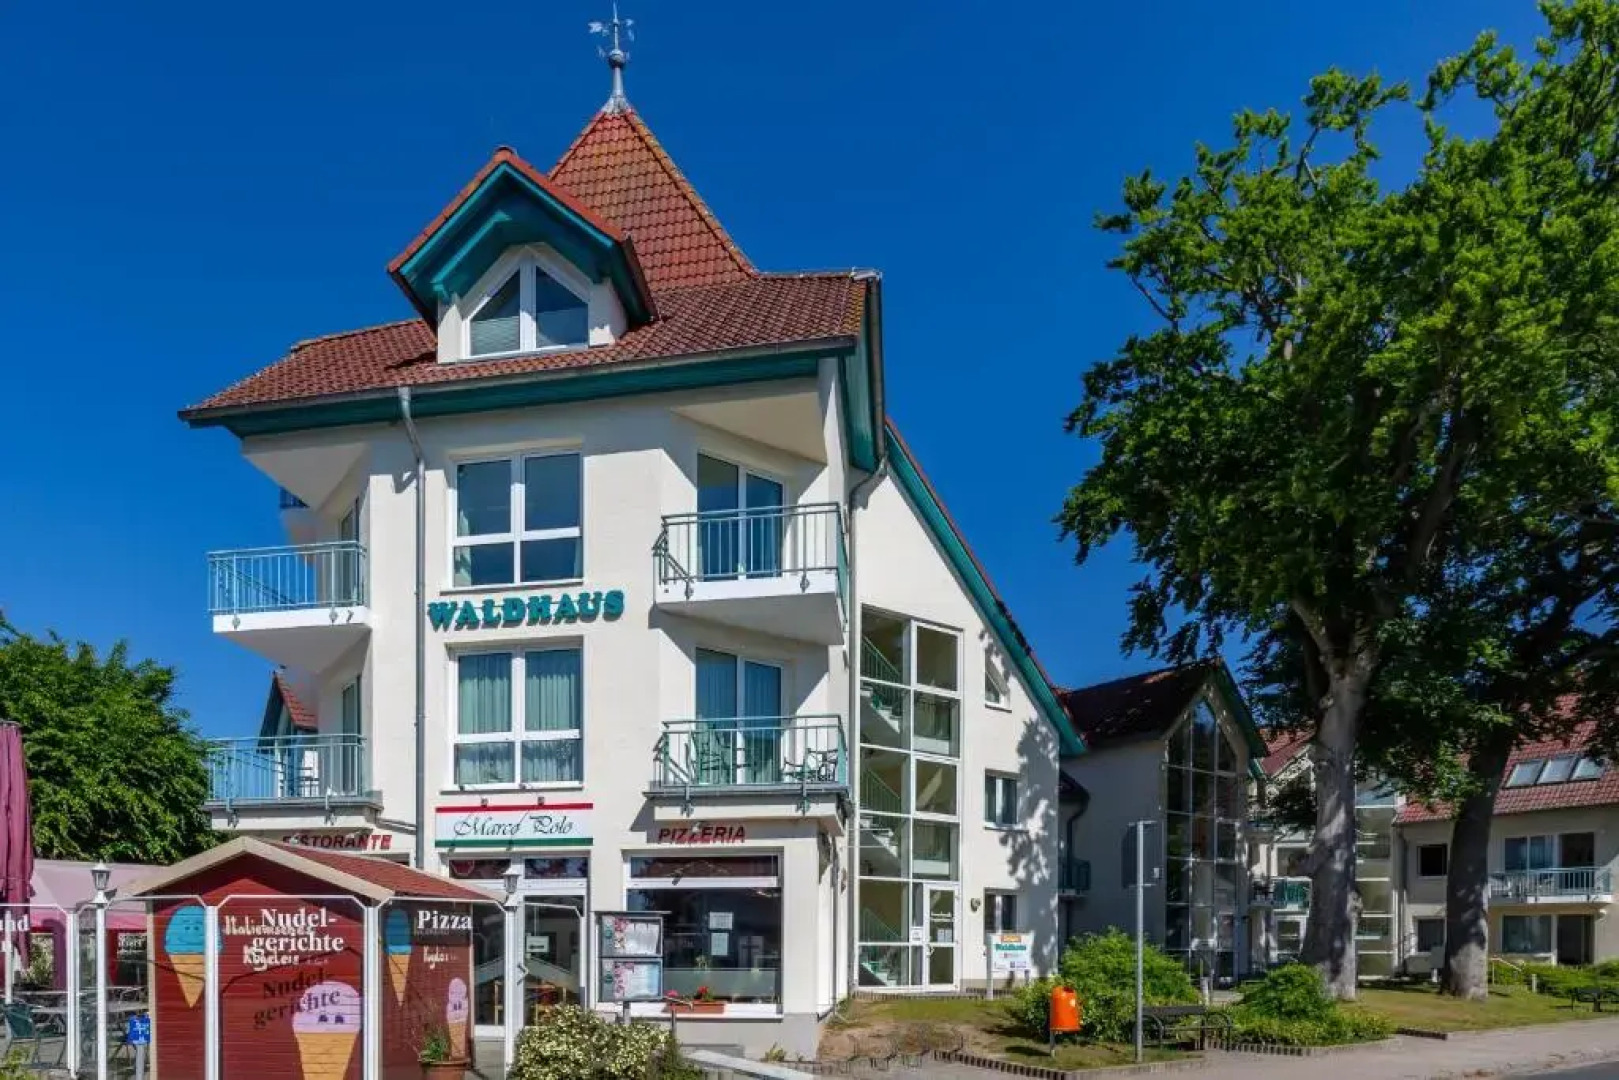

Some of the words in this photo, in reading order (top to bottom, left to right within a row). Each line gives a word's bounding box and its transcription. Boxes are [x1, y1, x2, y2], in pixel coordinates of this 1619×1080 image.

[427, 590, 625, 632] WALDHAUS
[453, 813, 522, 836] Marco
[529, 815, 574, 834] Polo
[260, 907, 338, 928] Nudel-
[417, 910, 473, 930] Pizza
[252, 932, 344, 962] gerichte
